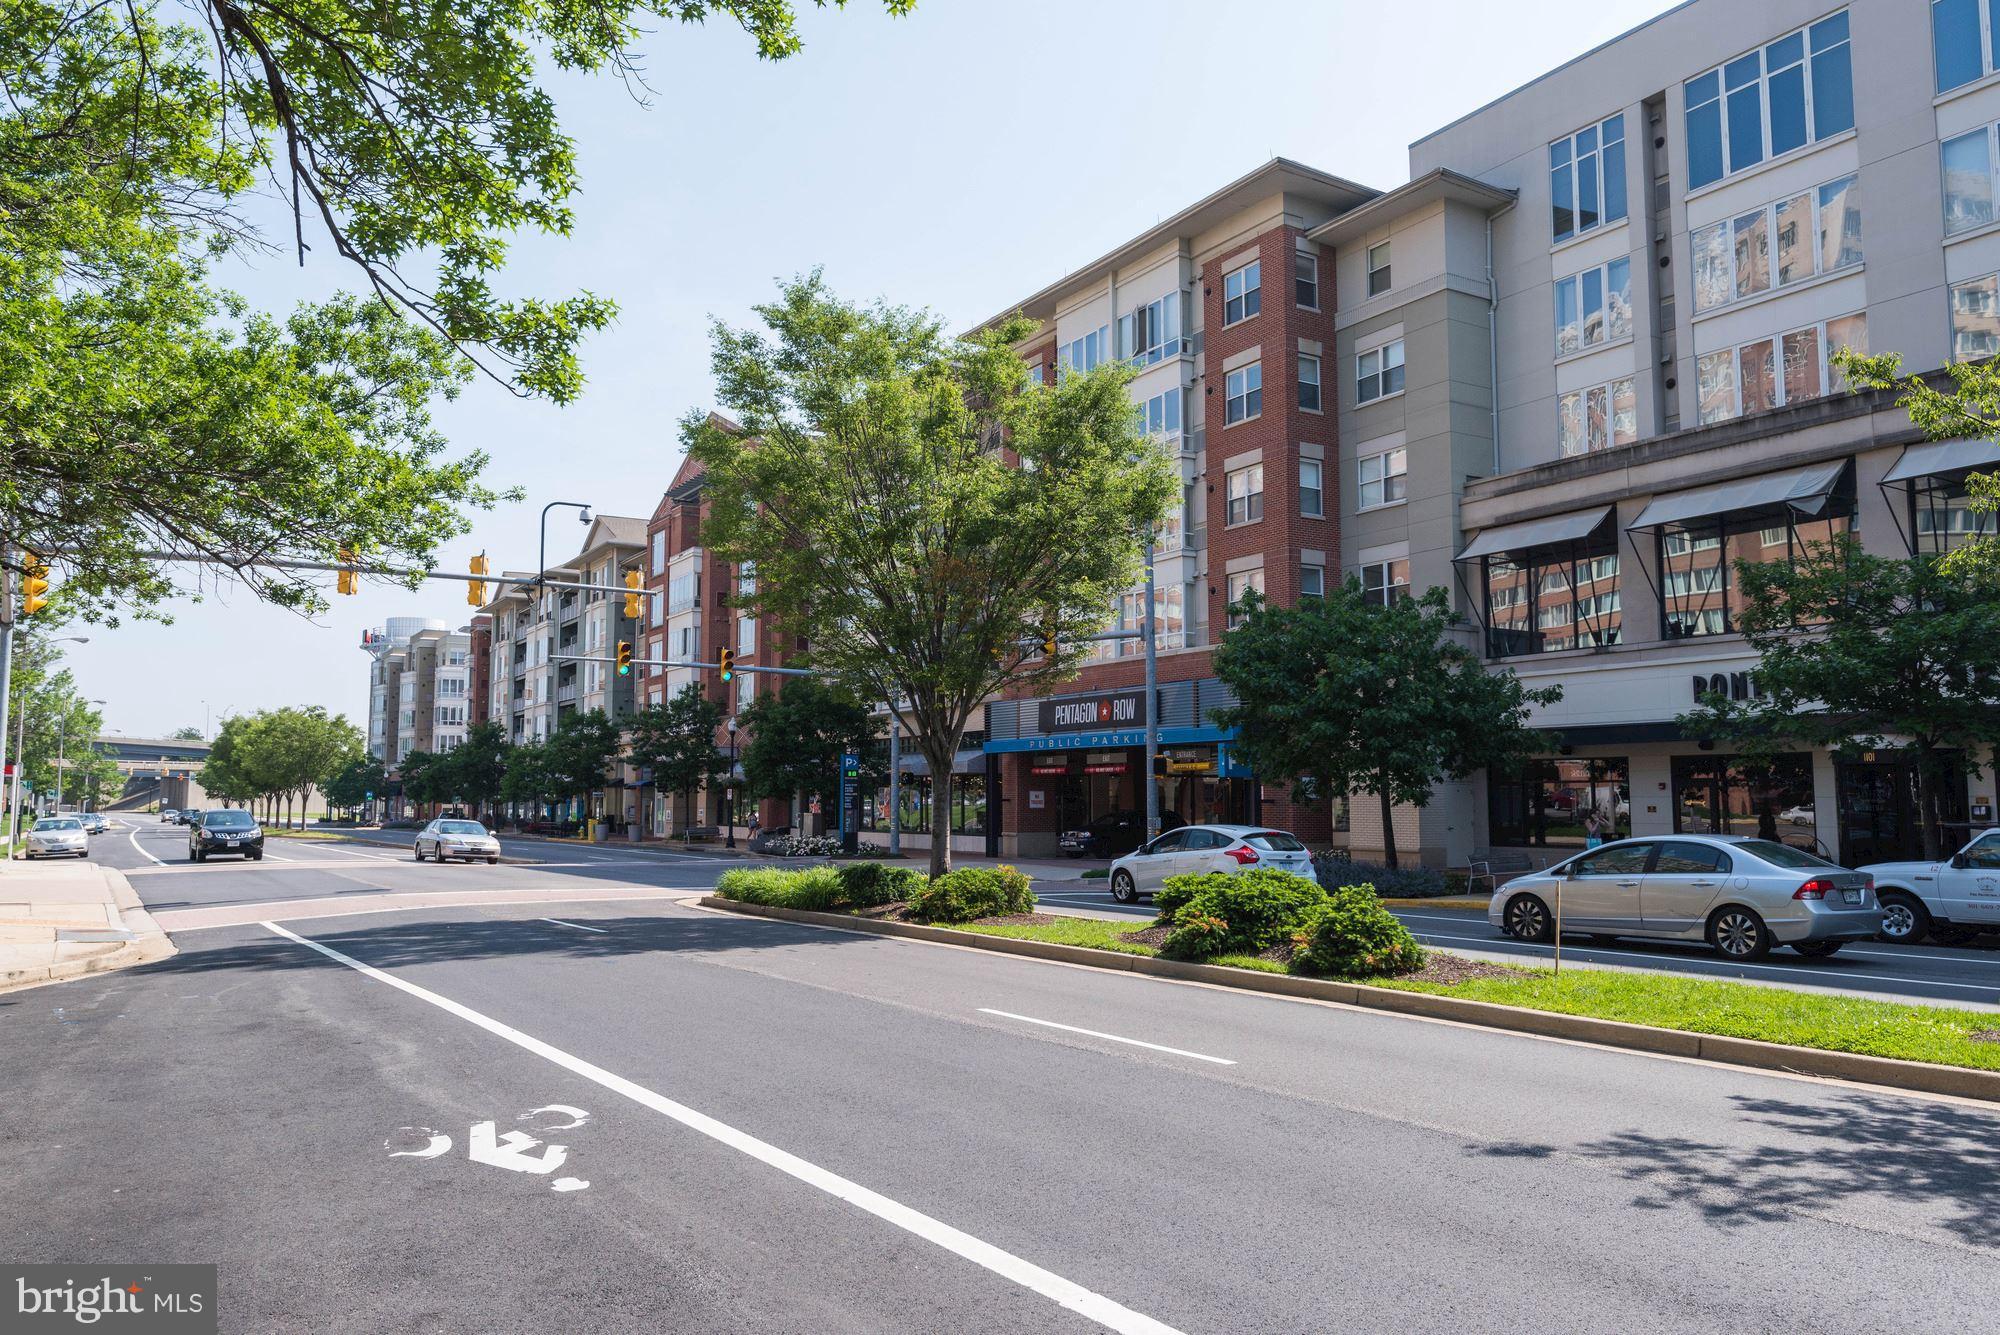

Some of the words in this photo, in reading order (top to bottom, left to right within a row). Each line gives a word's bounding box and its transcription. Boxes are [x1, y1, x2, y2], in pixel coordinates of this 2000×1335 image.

[1055, 702, 1098, 725] PENTAGON
[1112, 698, 1136, 720] ROW
[1029, 737, 1081, 749] PUBLIC
